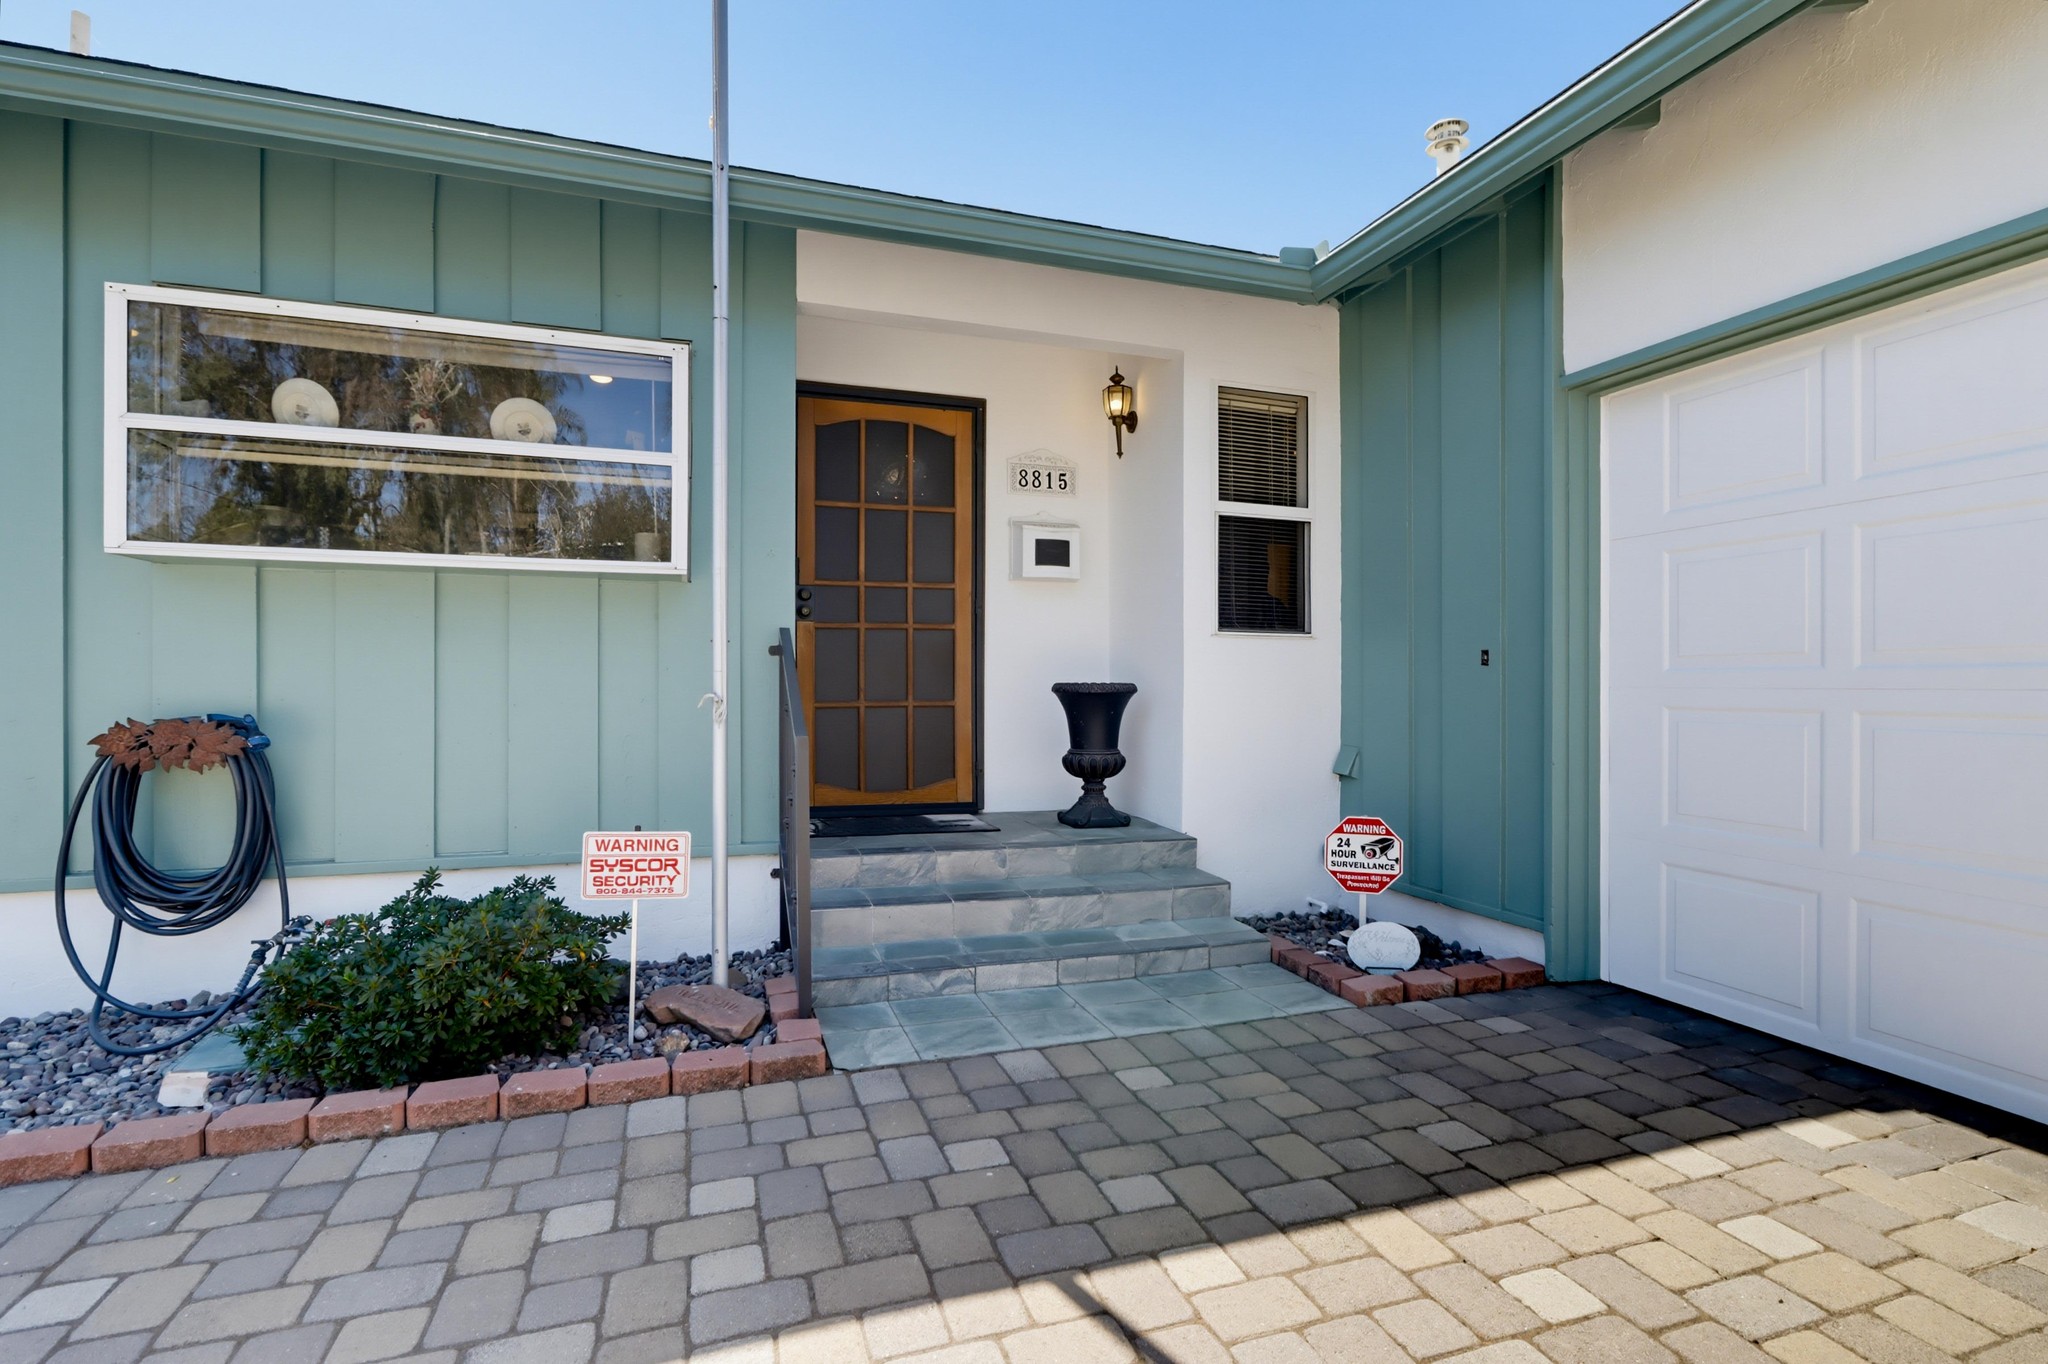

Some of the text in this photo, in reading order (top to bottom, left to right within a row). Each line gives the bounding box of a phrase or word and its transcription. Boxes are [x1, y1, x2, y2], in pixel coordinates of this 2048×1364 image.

[1018, 468, 1068, 490] 8815
[1343, 823, 1387, 834] WARNING
[594, 838, 679, 852] WARNING
[1336, 837, 1351, 848] 24
[1331, 849, 1357, 859] HOUR
[589, 858, 681, 875] SYSCOR
[1330, 860, 1396, 871] SURVEILLANCE
[592, 875, 678, 887] SECURITY
